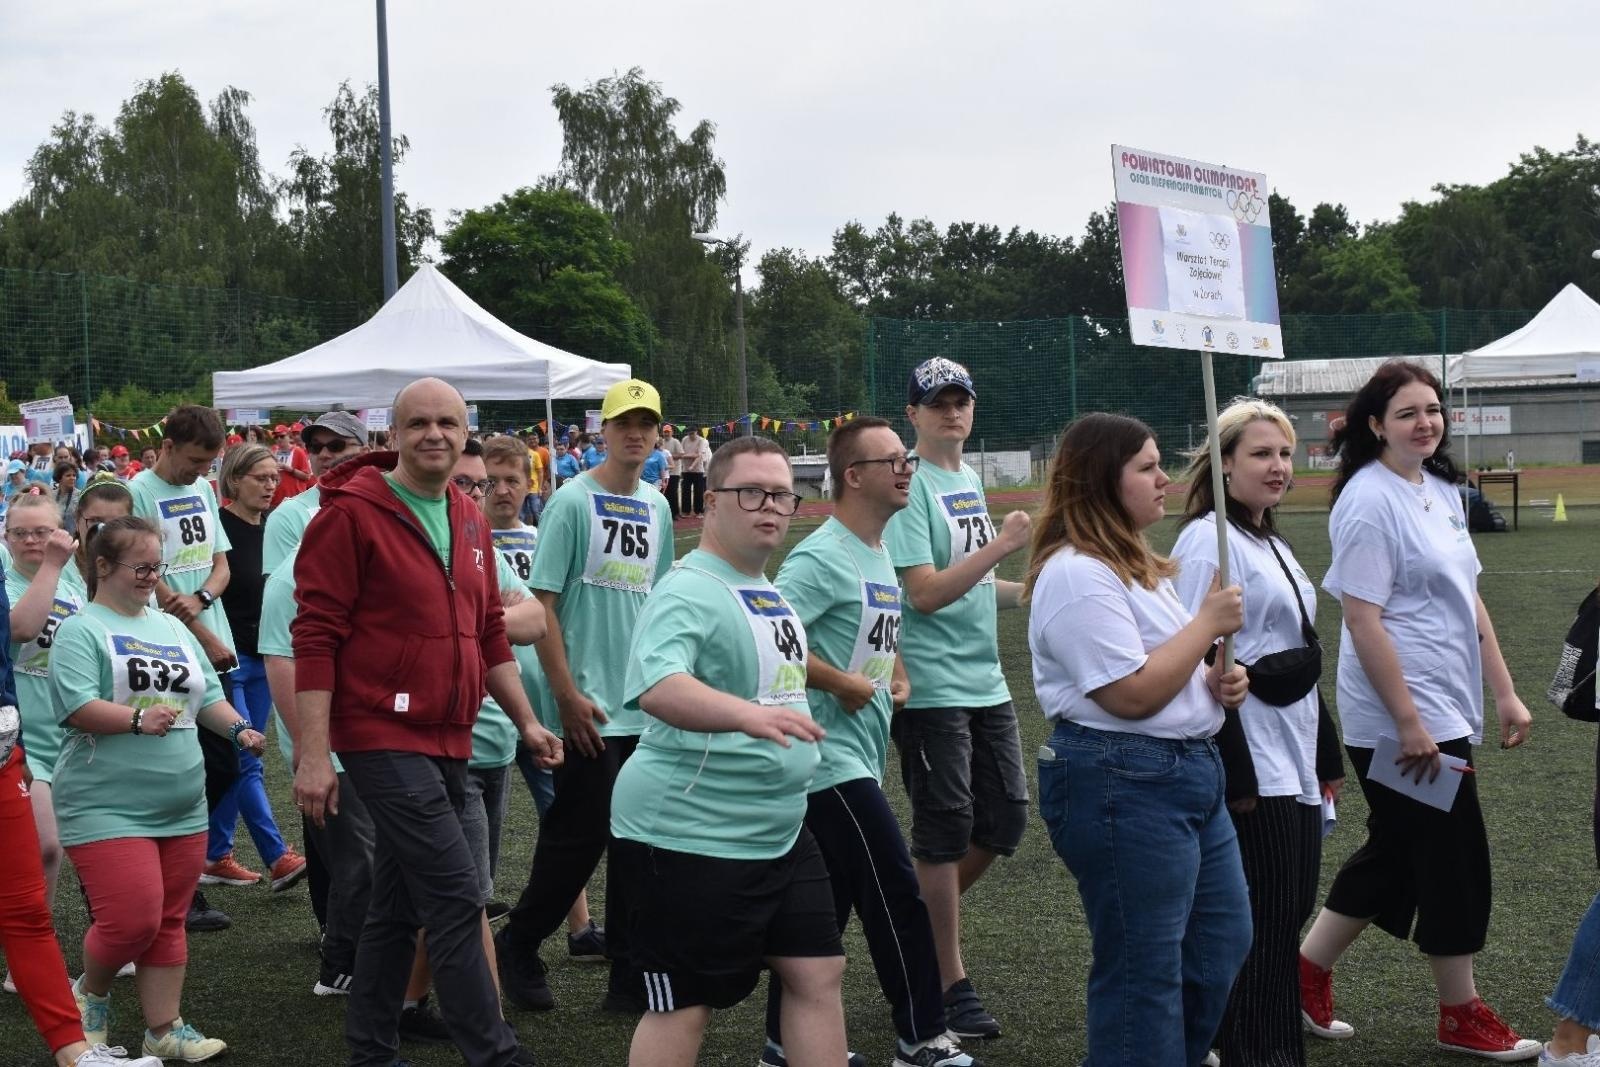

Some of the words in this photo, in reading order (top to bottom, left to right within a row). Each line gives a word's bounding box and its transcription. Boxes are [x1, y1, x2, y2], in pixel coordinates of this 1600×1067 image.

[1122, 152, 1192, 180] POWIATOWA
[1194, 167, 1251, 192] OLIMPIADA
[1176, 251, 1207, 265] Warsztat
[179, 516, 206, 546] 89
[602, 519, 649, 560] 765
[770, 619, 803, 662] 48
[127, 657, 190, 694] 632
